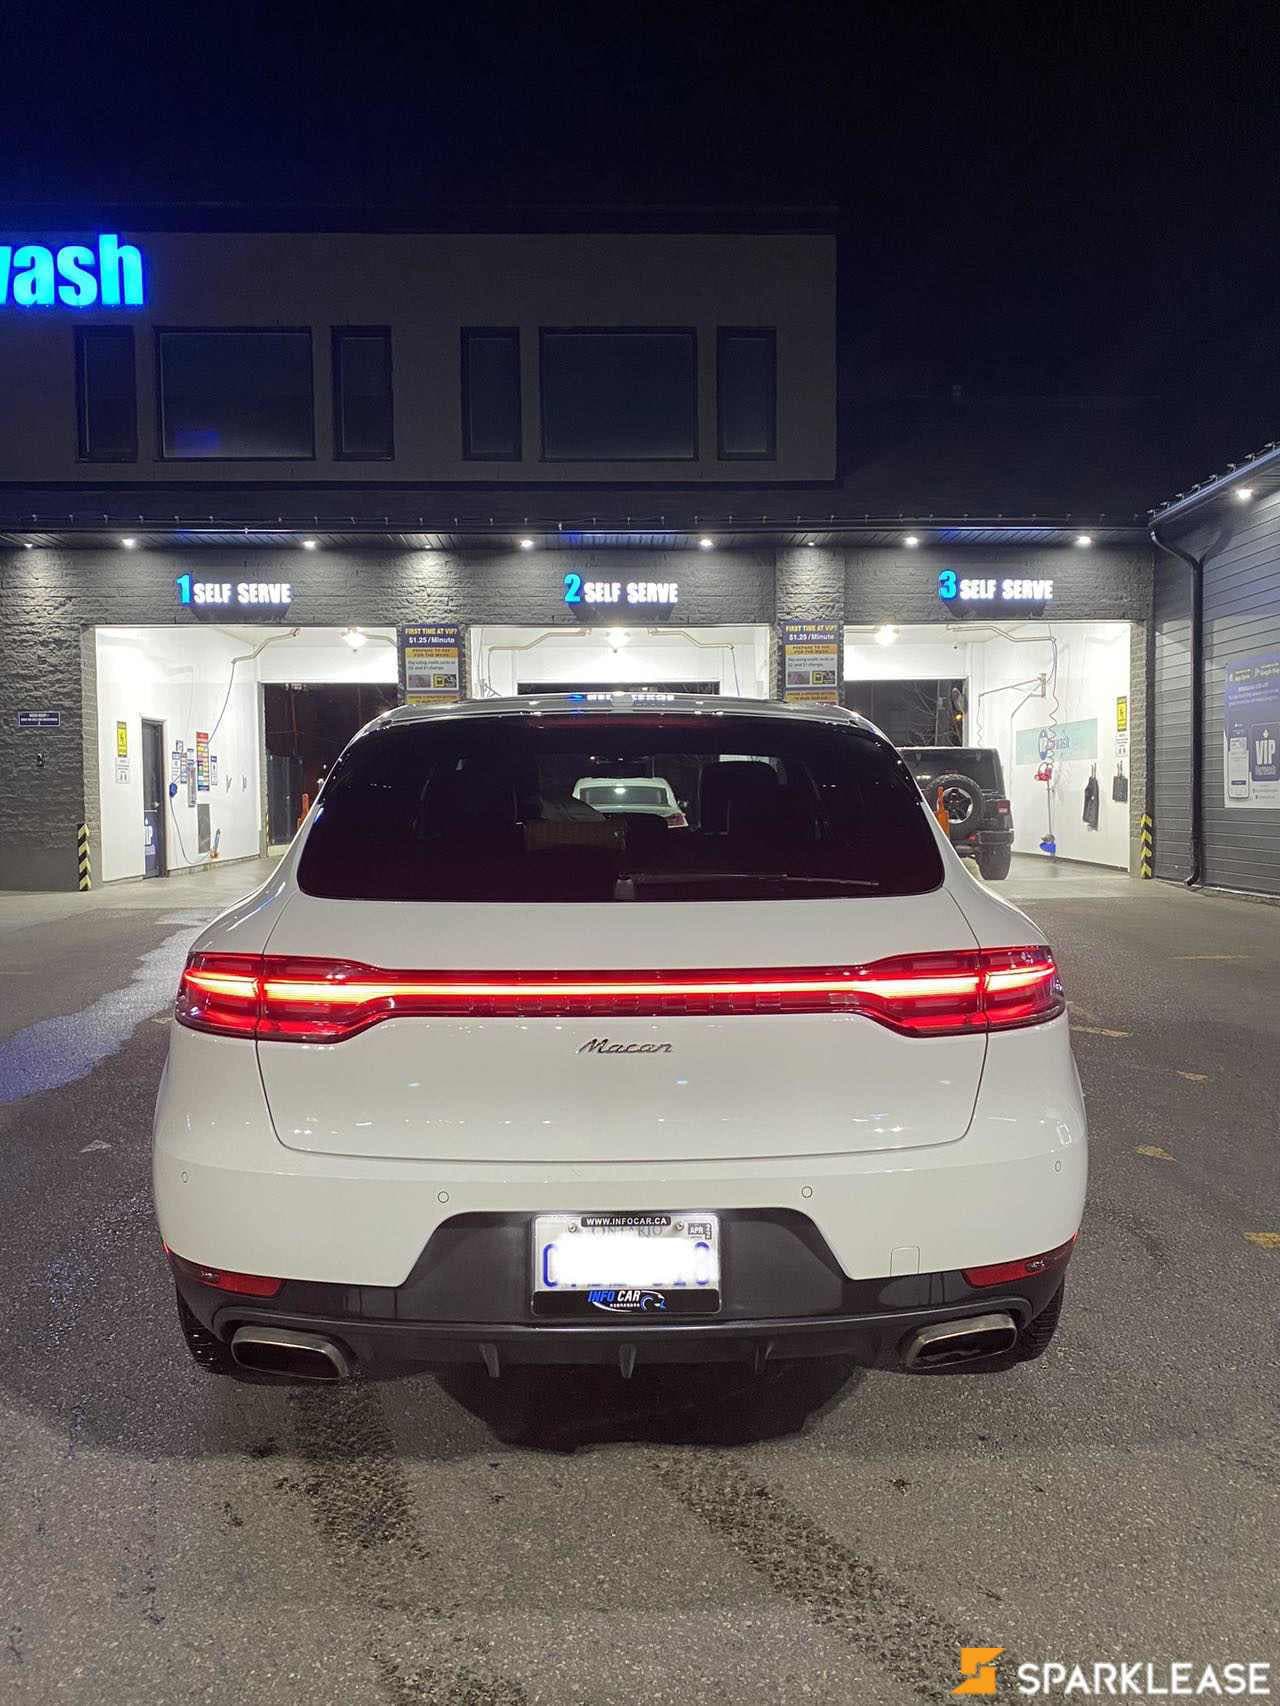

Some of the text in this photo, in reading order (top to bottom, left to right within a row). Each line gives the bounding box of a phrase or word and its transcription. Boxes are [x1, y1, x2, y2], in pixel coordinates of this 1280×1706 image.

[0, 234, 144, 306] ash
[177, 575, 291, 603] 1 SELF SERVE
[564, 574, 678, 603] 2 SELF SERVE
[939, 571, 1053, 599] 3 SELF SERVE
[579, 1038, 672, 1054] Macan
[586, 1217, 668, 1226] WWW.INFOCAR.CA
[588, 1290, 641, 1302] INFO CAR
